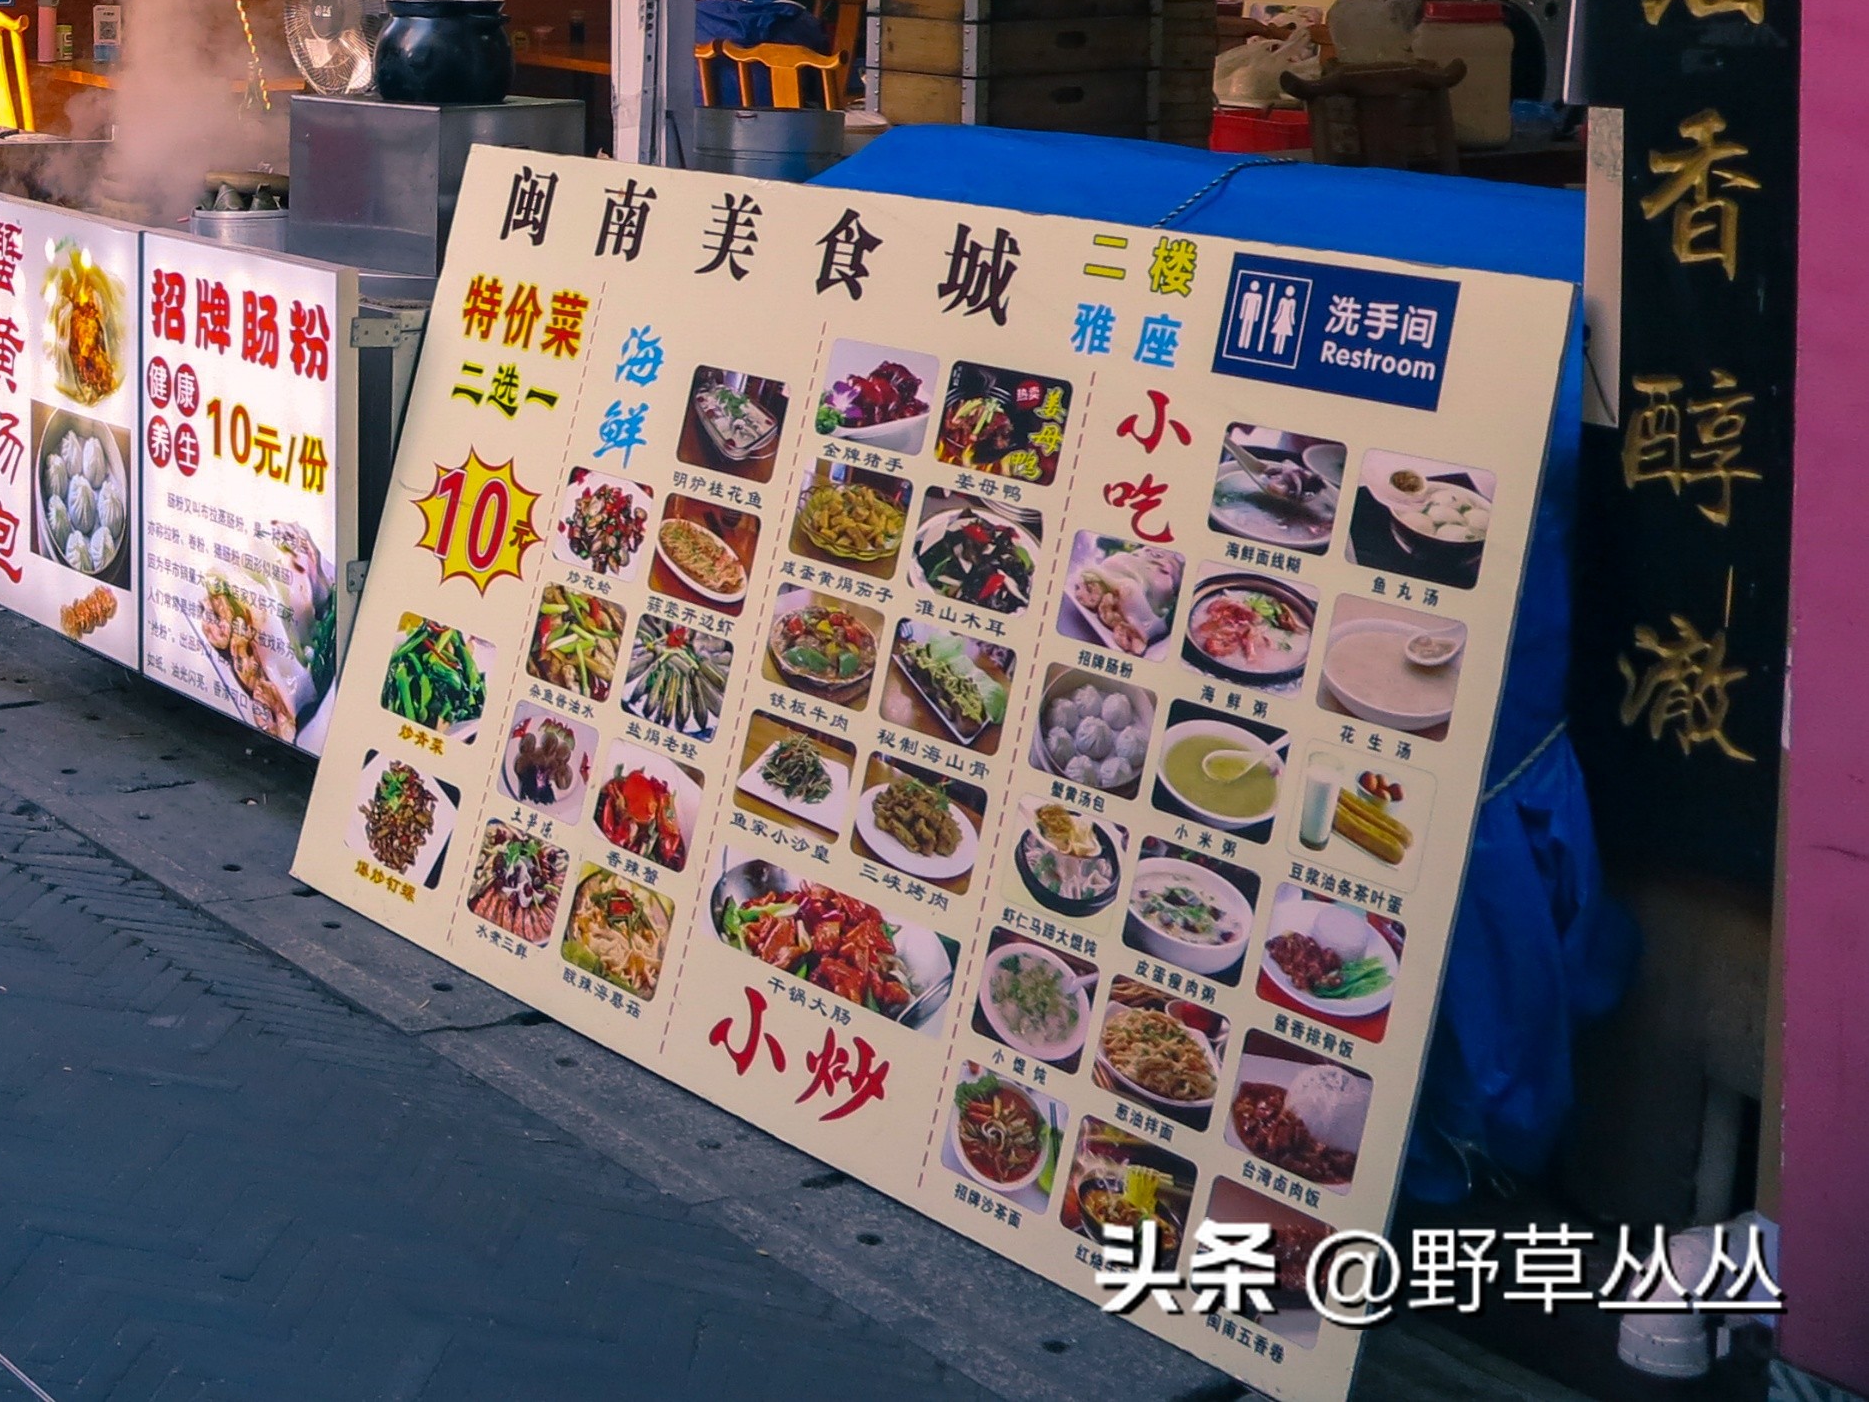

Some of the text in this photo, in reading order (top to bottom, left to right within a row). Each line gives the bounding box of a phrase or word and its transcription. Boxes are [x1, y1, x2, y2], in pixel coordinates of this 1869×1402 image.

[500, 165, 1023, 327] 闽南美食城
[1083, 233, 1200, 299] 二楼
[150, 266, 332, 383] 招牌肠粉
[462, 272, 590, 360] 特价菜
[1069, 302, 1184, 369] 雅座
[1324, 293, 1439, 350] 洗手间
[1319, 340, 1437, 383] Restroom
[148, 361, 196, 415] 健康
[451, 360, 560, 421] 二选一
[591, 323, 666, 470] 海鲜
[148, 422, 198, 472] 养生
[206, 395, 330, 495] 10元/份
[822, 442, 906, 473] 金牌猪手
[1101, 389, 1195, 546] 小吃
[671, 470, 764, 511] 明炉桂花鱼
[954, 471, 1024, 503] 姜母鸭
[432, 467, 532, 573] 10元
[1225, 540, 1304, 575] 海鲜面线糊
[565, 570, 612, 597] 炒花蛤
[779, 559, 895, 605] 咸蛋黄焗茄子
[1371, 576, 1441, 610] 鱼丸汤
[645, 595, 737, 637] 蒜蓉开边虾
[913, 597, 1008, 638] 淮山木耳
[1076, 649, 1135, 681] 招牌肠粉
[528, 682, 596, 720] 杂鱼酱油水
[768, 690, 850, 732] 铁板牛肉
[1199, 684, 1269, 719] 海鲜粥
[624, 720, 700, 761] 盐焗老蛏
[877, 727, 992, 781] 秘制海山骨
[1339, 725, 1414, 761] 花生汤
[1049, 780, 1107, 815] 蟹黄汤包
[509, 807, 555, 840] 土笋冻
[1174, 822, 1239, 860] 小米粥
[353, 857, 418, 906] 爆炒钉螺
[605, 849, 661, 887] 香辣蟹
[858, 862, 950, 913] 三峡烤肉
[1287, 860, 1405, 917] 豆浆油条茶叶蛋
[475, 923, 530, 961] 水煮三鲜
[1000, 905, 1099, 958] 虾仁马蹄大馄饨
[766, 975, 853, 1027] 干锅大肠
[1133, 958, 1218, 1006] 皮蛋瘦肉粥
[707, 985, 892, 1123] 小炒
[1272, 1011, 1356, 1061] 酱香排骨饭
[991, 1046, 1050, 1089] 小馄饨
[1113, 1101, 1175, 1145] 葱油拌面
[952, 1181, 1024, 1232] 招牌沙茶面
[1239, 1158, 1322, 1212] 台湾卤肉饭
